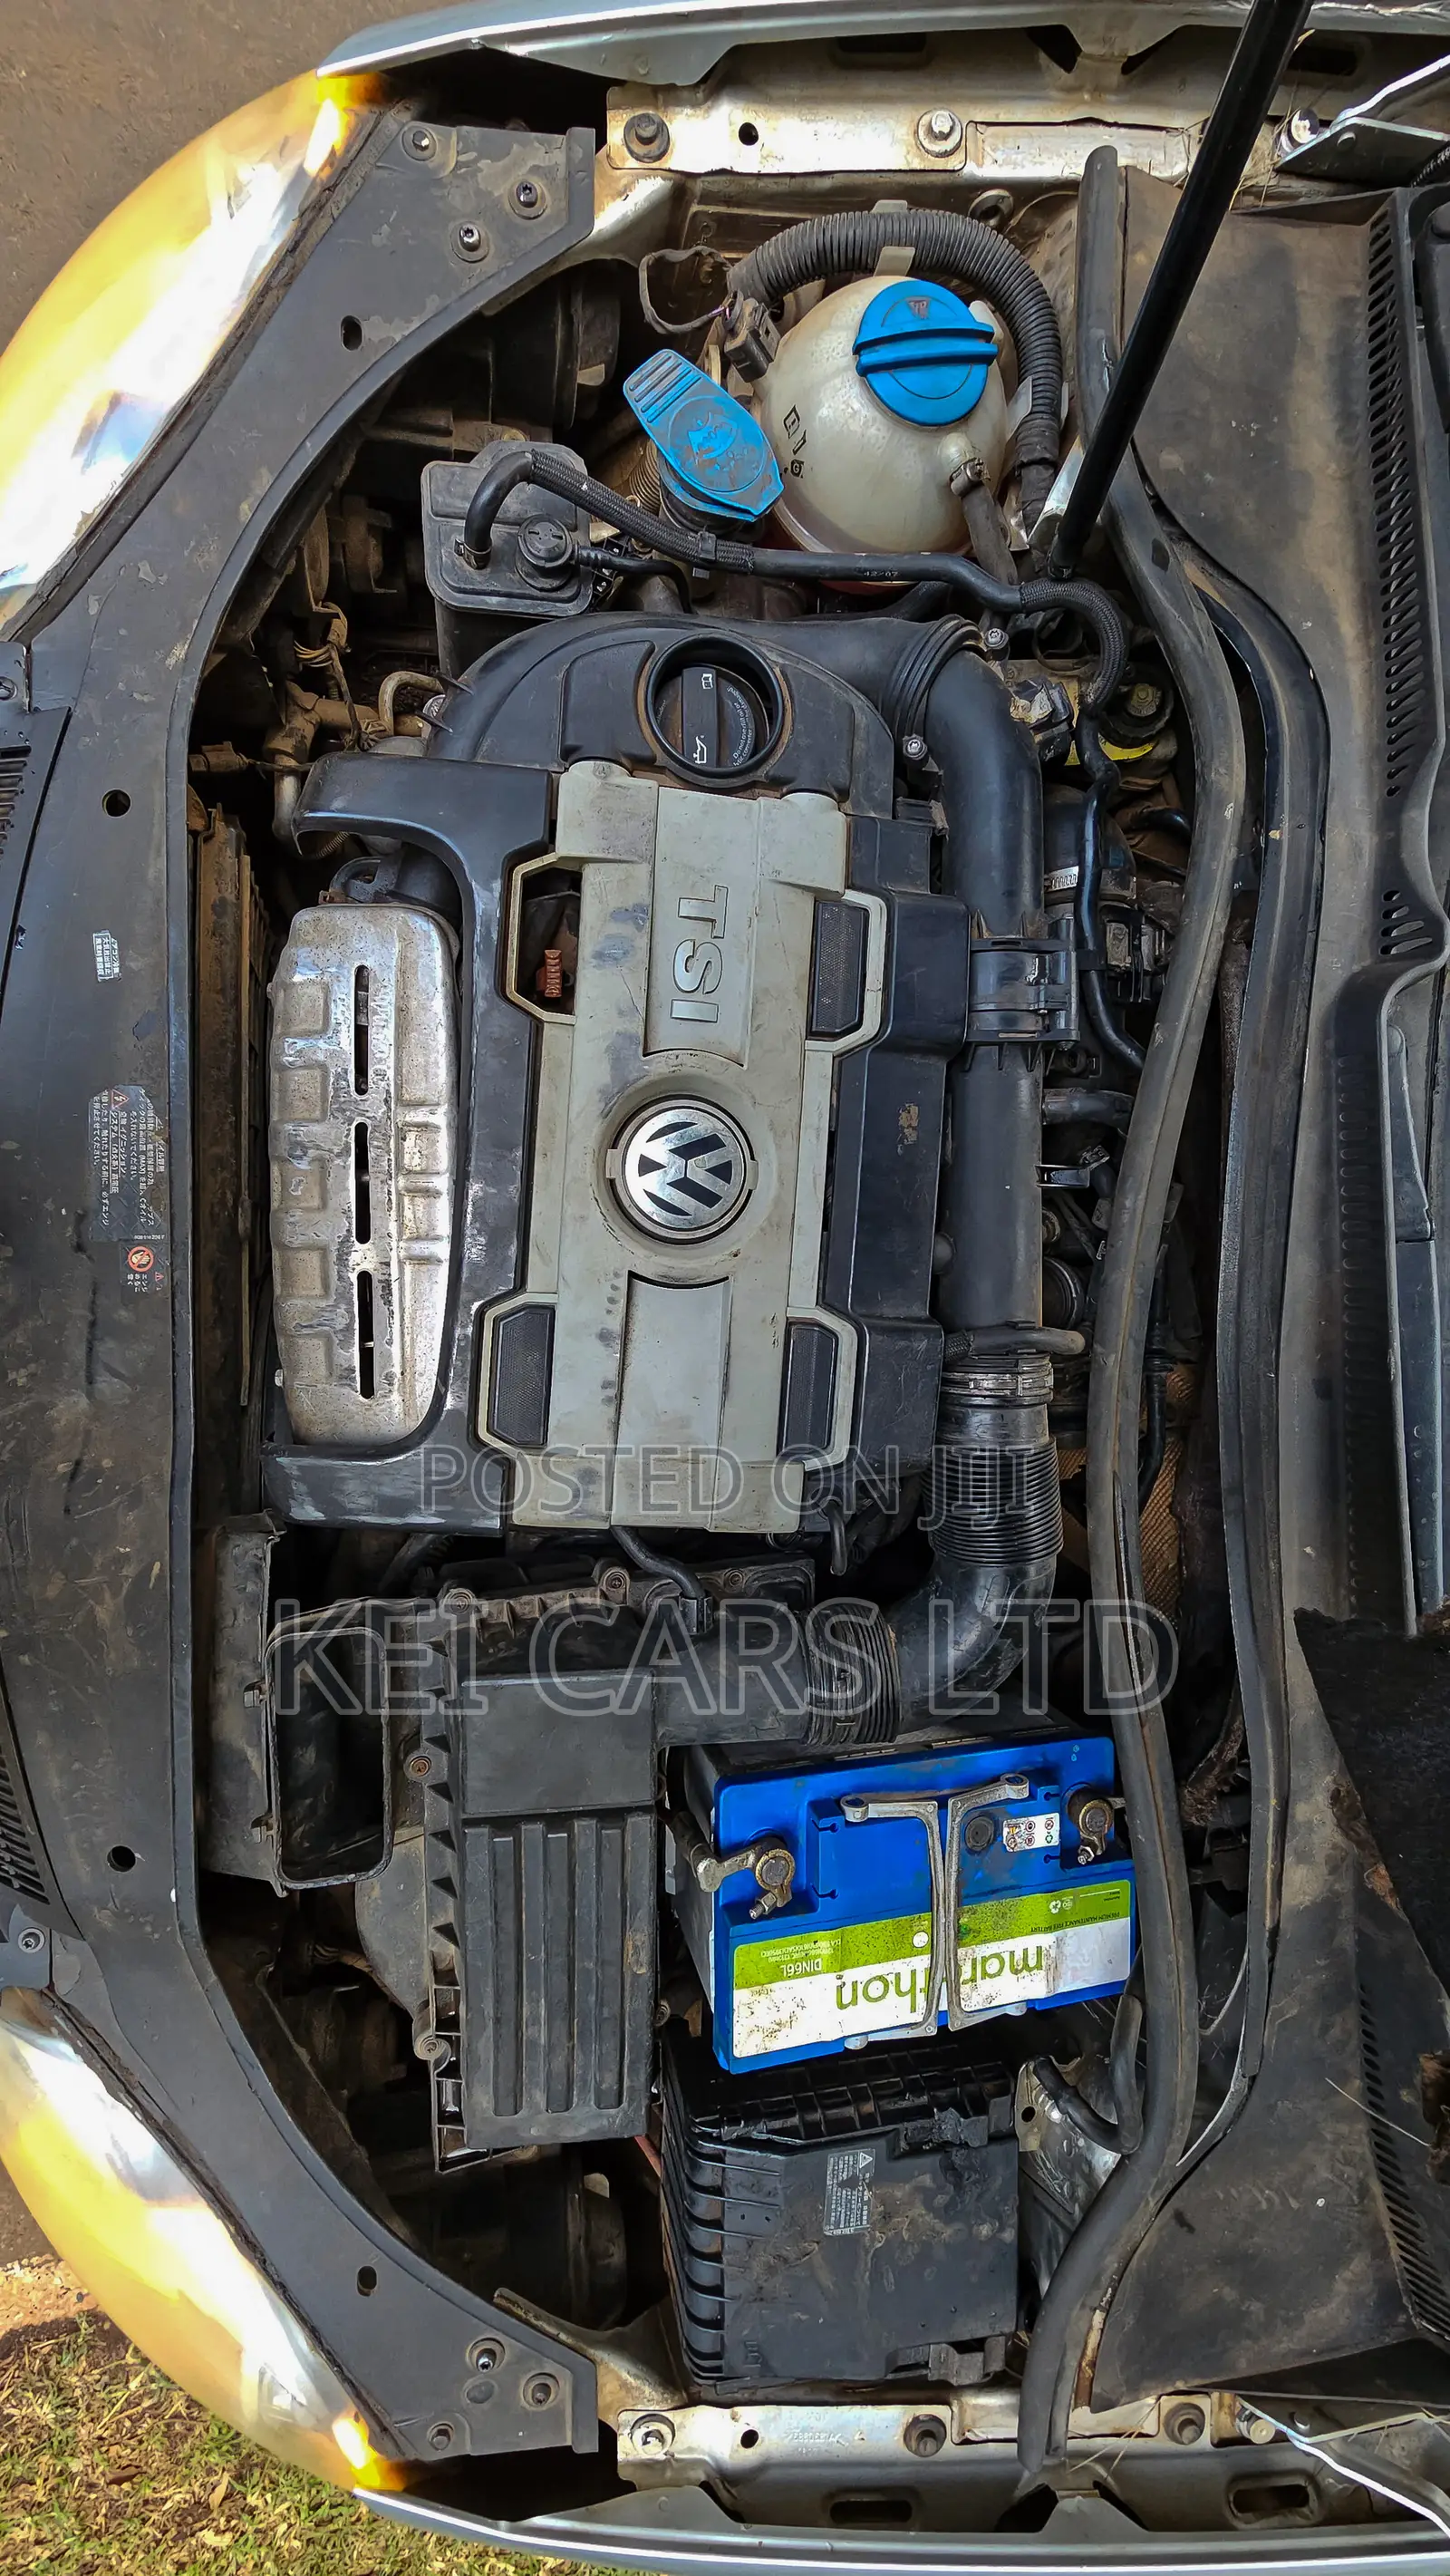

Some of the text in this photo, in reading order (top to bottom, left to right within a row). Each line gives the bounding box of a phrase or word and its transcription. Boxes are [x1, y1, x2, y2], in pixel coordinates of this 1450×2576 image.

[670, 885, 729, 1023] TSI
[1064, 1915, 1097, 1928] MAINTENANCE
[1097, 1911, 1120, 1922] PREMIUM
[1030, 1924, 1053, 1932] BATTERY
[779, 1958, 823, 1978] DIN66L
[835, 1944, 1043, 2014] marhon
